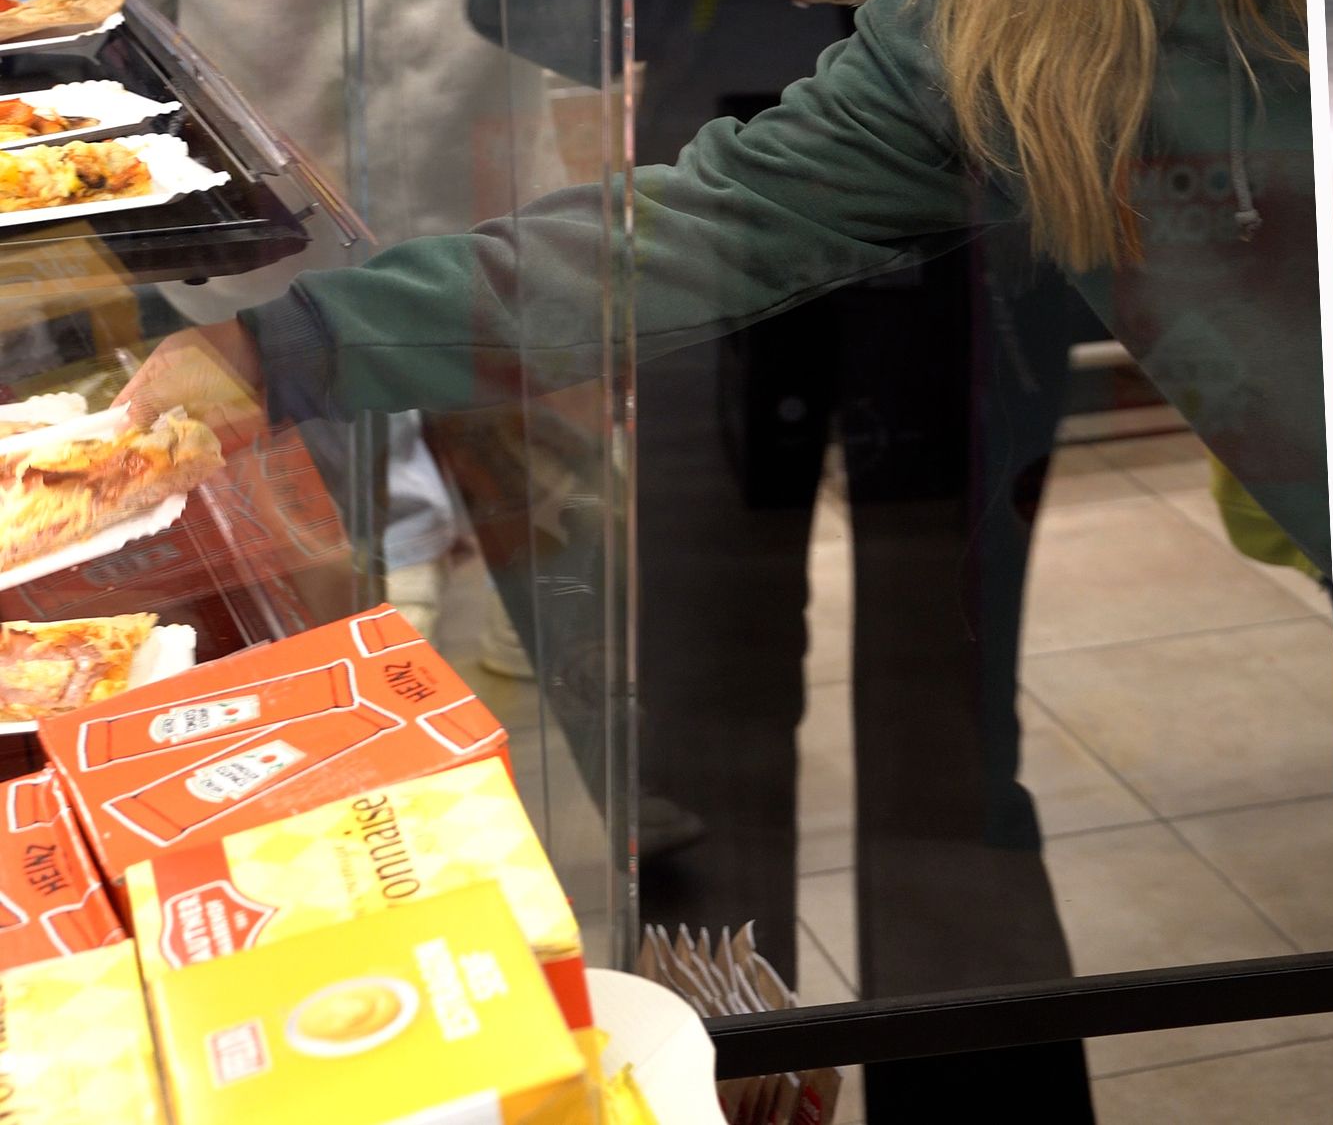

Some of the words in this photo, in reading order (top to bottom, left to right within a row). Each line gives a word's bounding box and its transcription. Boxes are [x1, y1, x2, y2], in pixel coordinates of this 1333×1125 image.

[384, 661, 438, 703] HEINZ
[23, 844, 70, 896] HEINZ
[343, 795, 421, 909] onnaise
